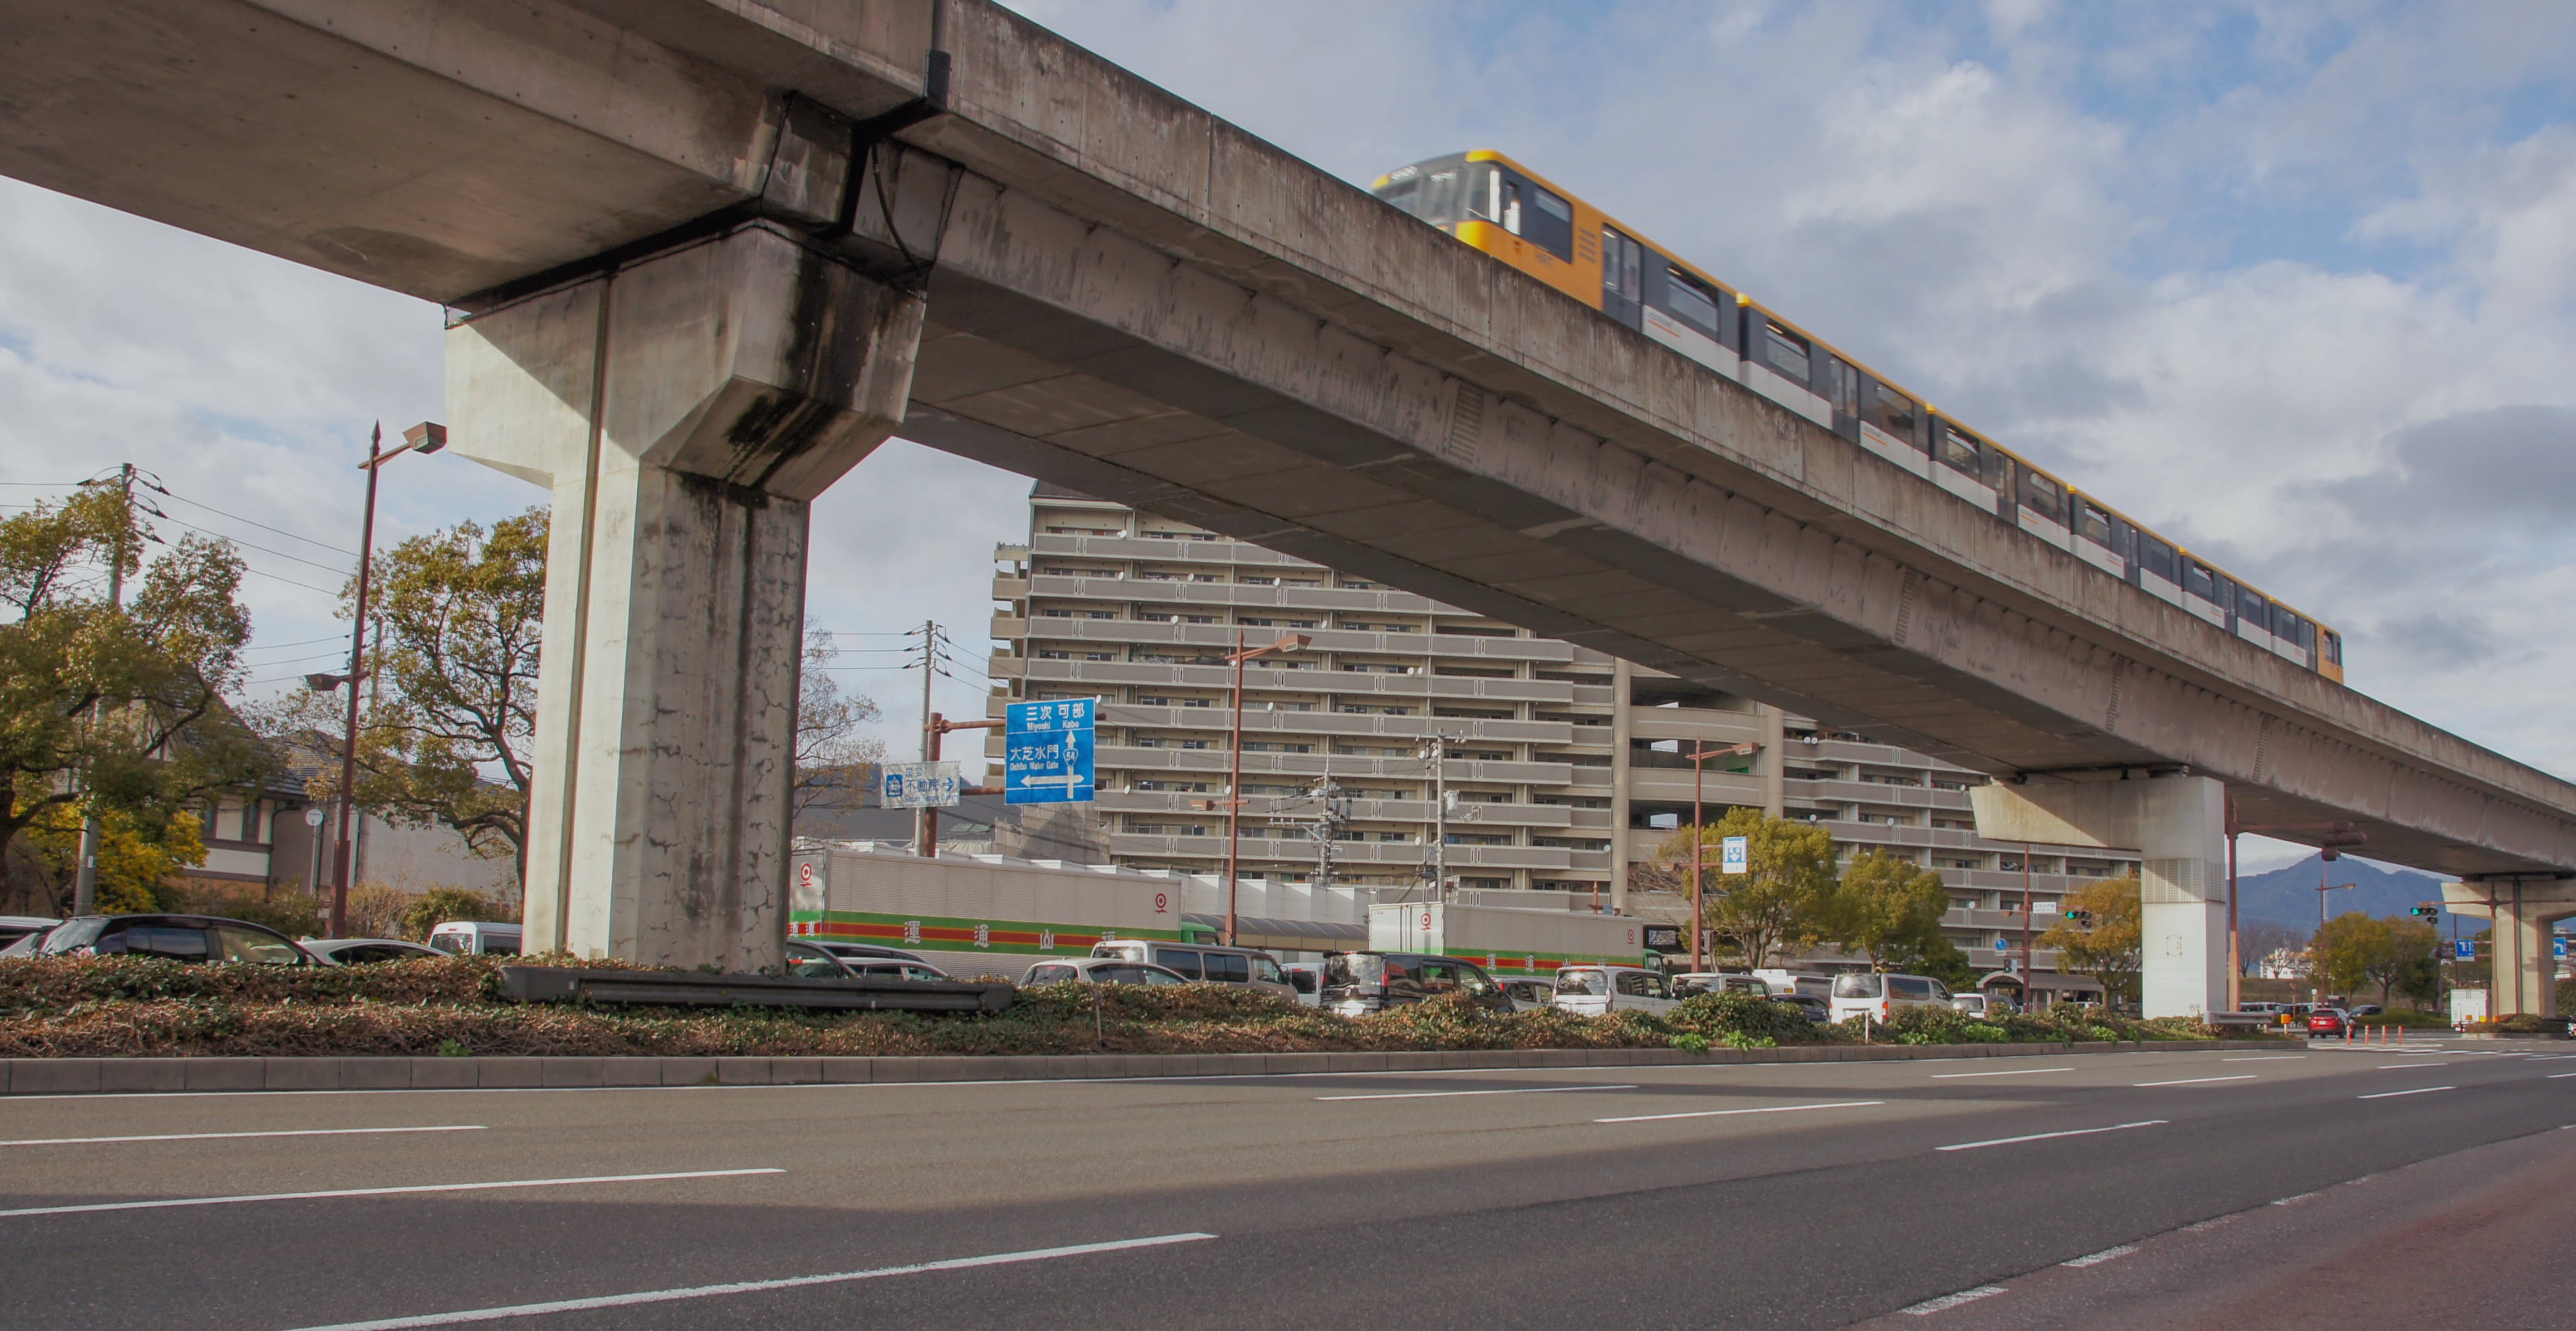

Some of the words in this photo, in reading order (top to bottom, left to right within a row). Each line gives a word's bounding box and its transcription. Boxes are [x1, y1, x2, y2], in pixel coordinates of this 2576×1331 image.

[1026, 705, 1052, 721] 三次
[1058, 702, 1085, 718] 可部
[1027, 721, 1051, 732] Miyoshi
[1063, 720, 1079, 729] Kabe
[1010, 744, 1059, 761] 大芝水門
[1066, 751, 1075, 761] 54
[1030, 761, 1044, 770] Water
[1046, 761, 1059, 769] Gate
[905, 778, 940, 793] 不動院
